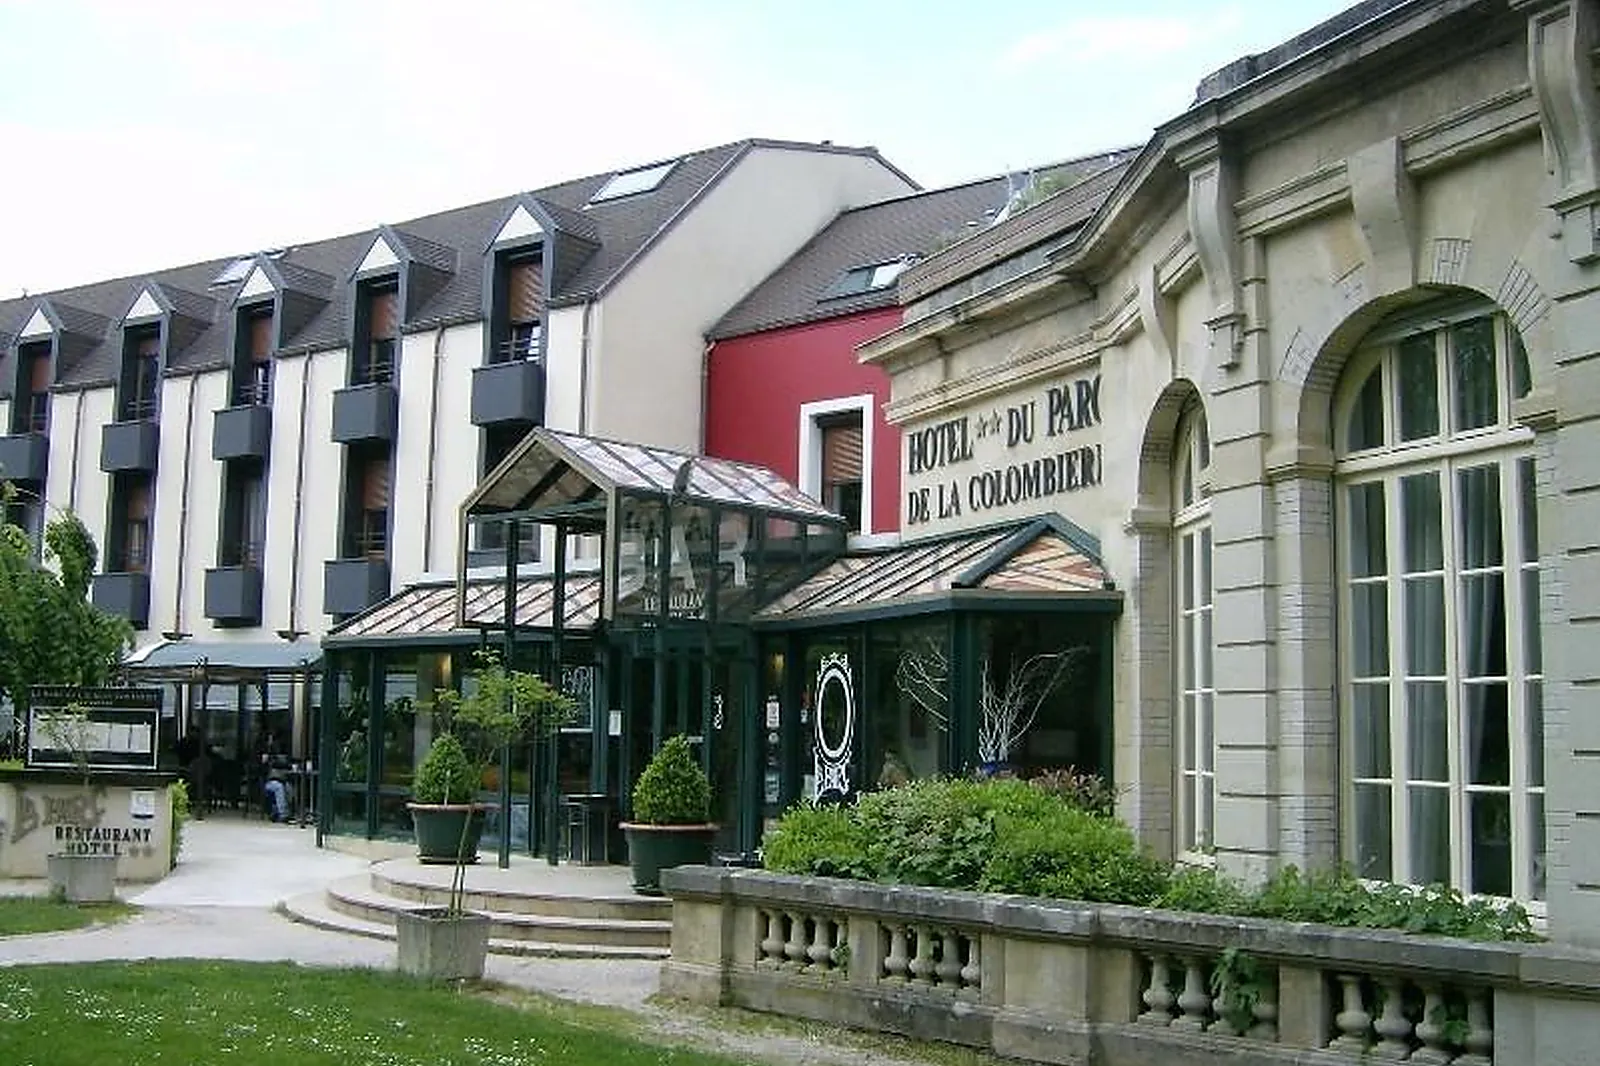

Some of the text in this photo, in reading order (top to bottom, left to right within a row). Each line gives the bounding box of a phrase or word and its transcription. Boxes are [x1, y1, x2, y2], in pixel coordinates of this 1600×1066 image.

[907, 416, 974, 475] HOTEL
[1006, 402, 1036, 447] DU
[907, 487, 931, 525] DE
[938, 478, 961, 519] LA
[55, 825, 152, 843] RESTAURANT
[65, 842, 122, 856] HOTEL
